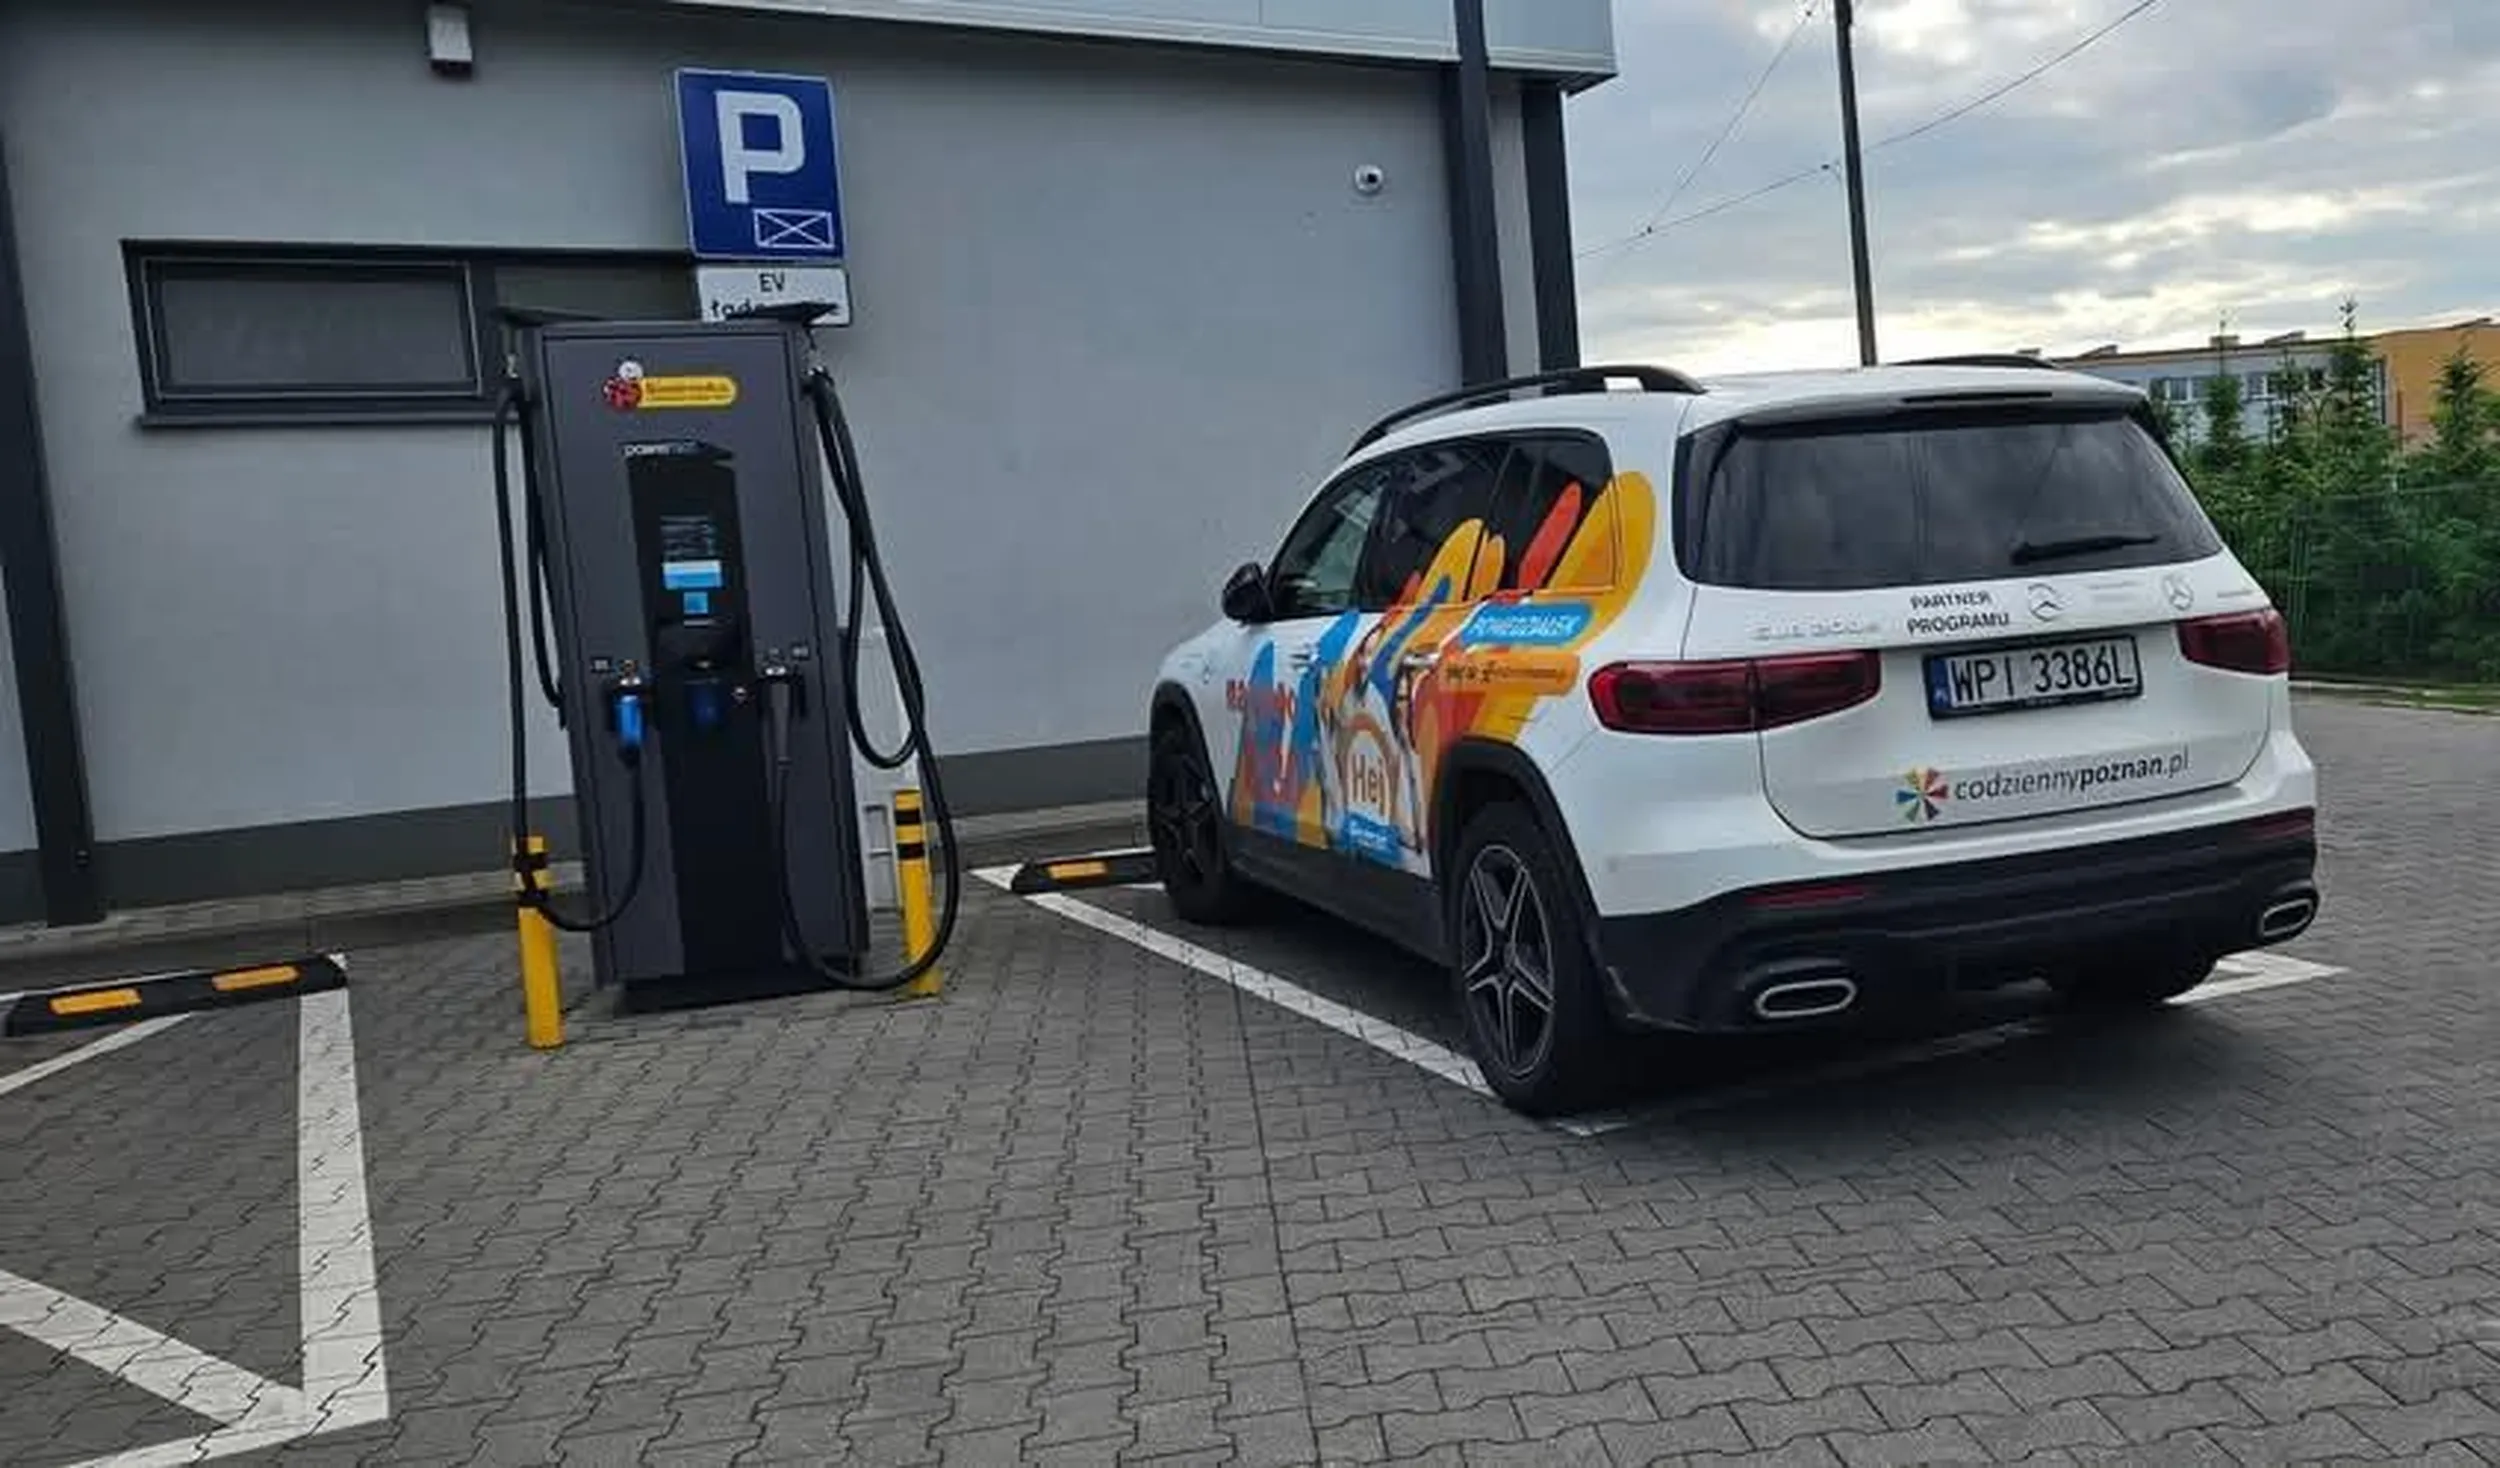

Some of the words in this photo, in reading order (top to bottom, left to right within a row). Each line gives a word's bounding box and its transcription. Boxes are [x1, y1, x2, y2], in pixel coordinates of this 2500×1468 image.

[714, 89, 805, 204] P
[758, 272, 786, 292] EV
[1906, 612, 2011, 636] PROGRAMU
[1909, 589, 1993, 611] PARTNER
[1951, 656, 2014, 702] WPI
[2030, 644, 2134, 693] 3386L
[1352, 753, 1387, 817] Hej
[1954, 743, 2188, 800] codziennypoznan.pl
